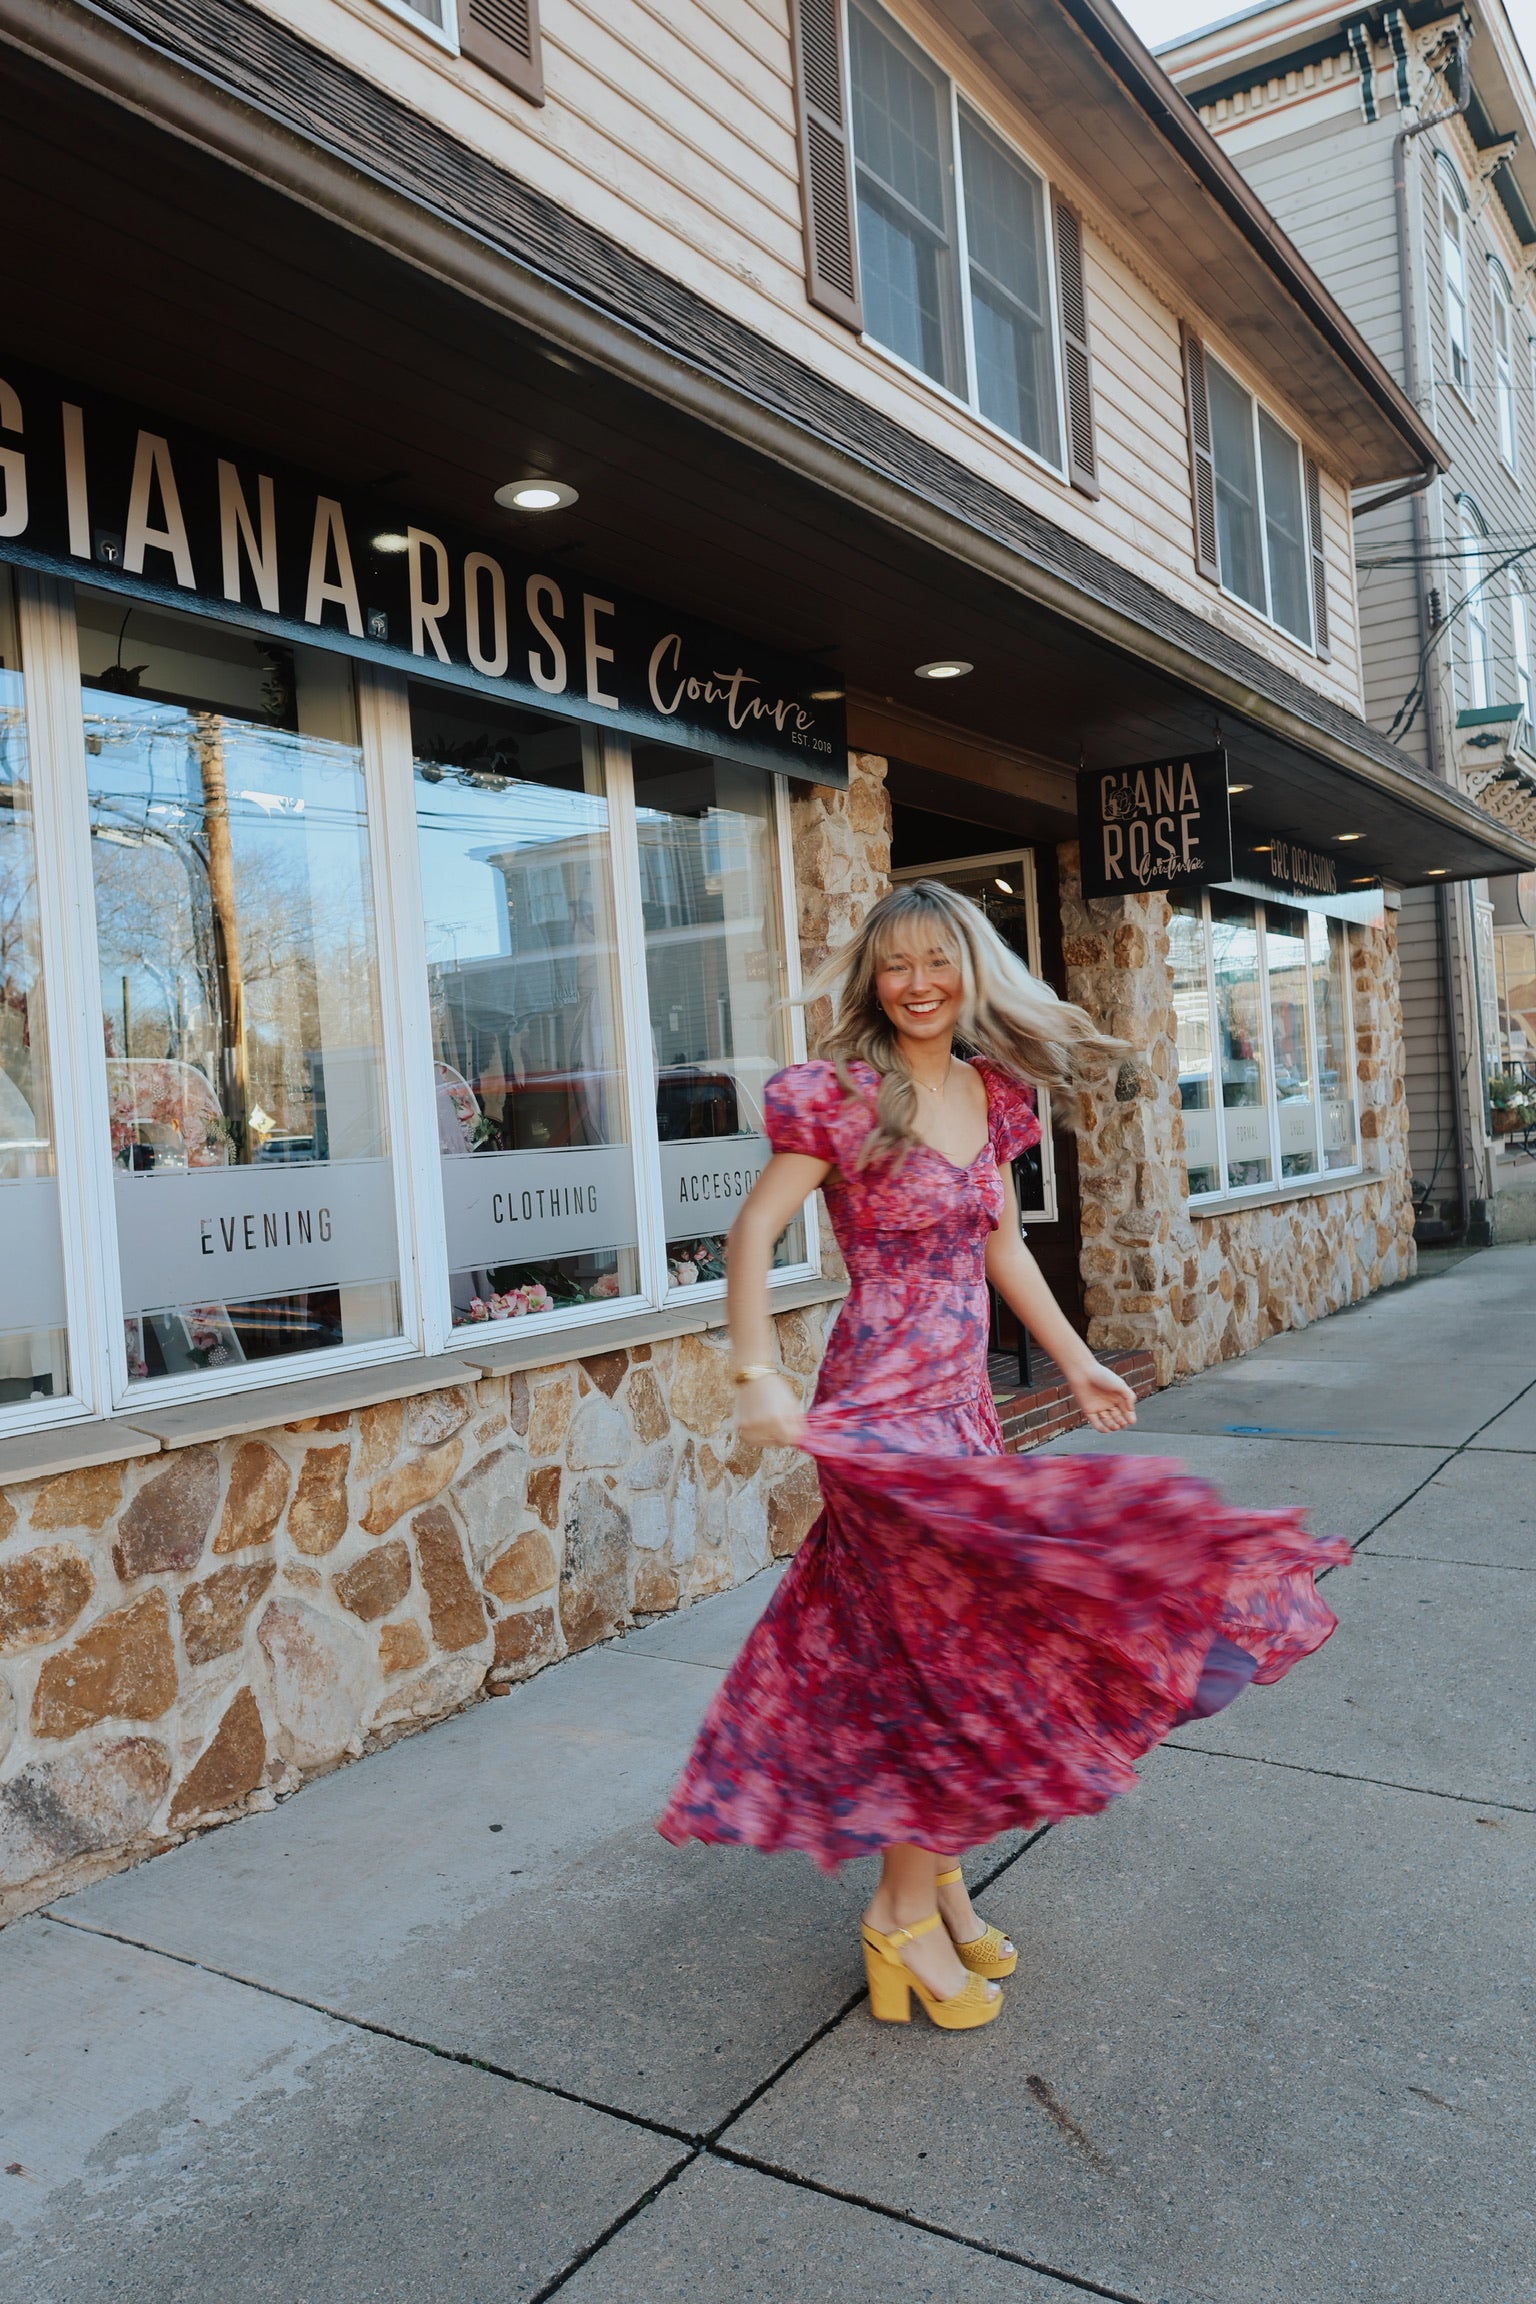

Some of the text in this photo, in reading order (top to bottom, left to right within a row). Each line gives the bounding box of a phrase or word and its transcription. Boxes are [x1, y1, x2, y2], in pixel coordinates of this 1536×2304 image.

[407, 526, 619, 710] ROSE
[648, 633, 815, 731] Couture
[791, 731, 832, 754] EST. 2018
[1103, 812, 1200, 880] ROSE
[1139, 852, 1205, 886] Couture
[1270, 839, 1337, 894] GRC OCCASIONS
[492, 1184, 598, 1224] CLOTHING
[200, 1208, 332, 1255] EVENING
